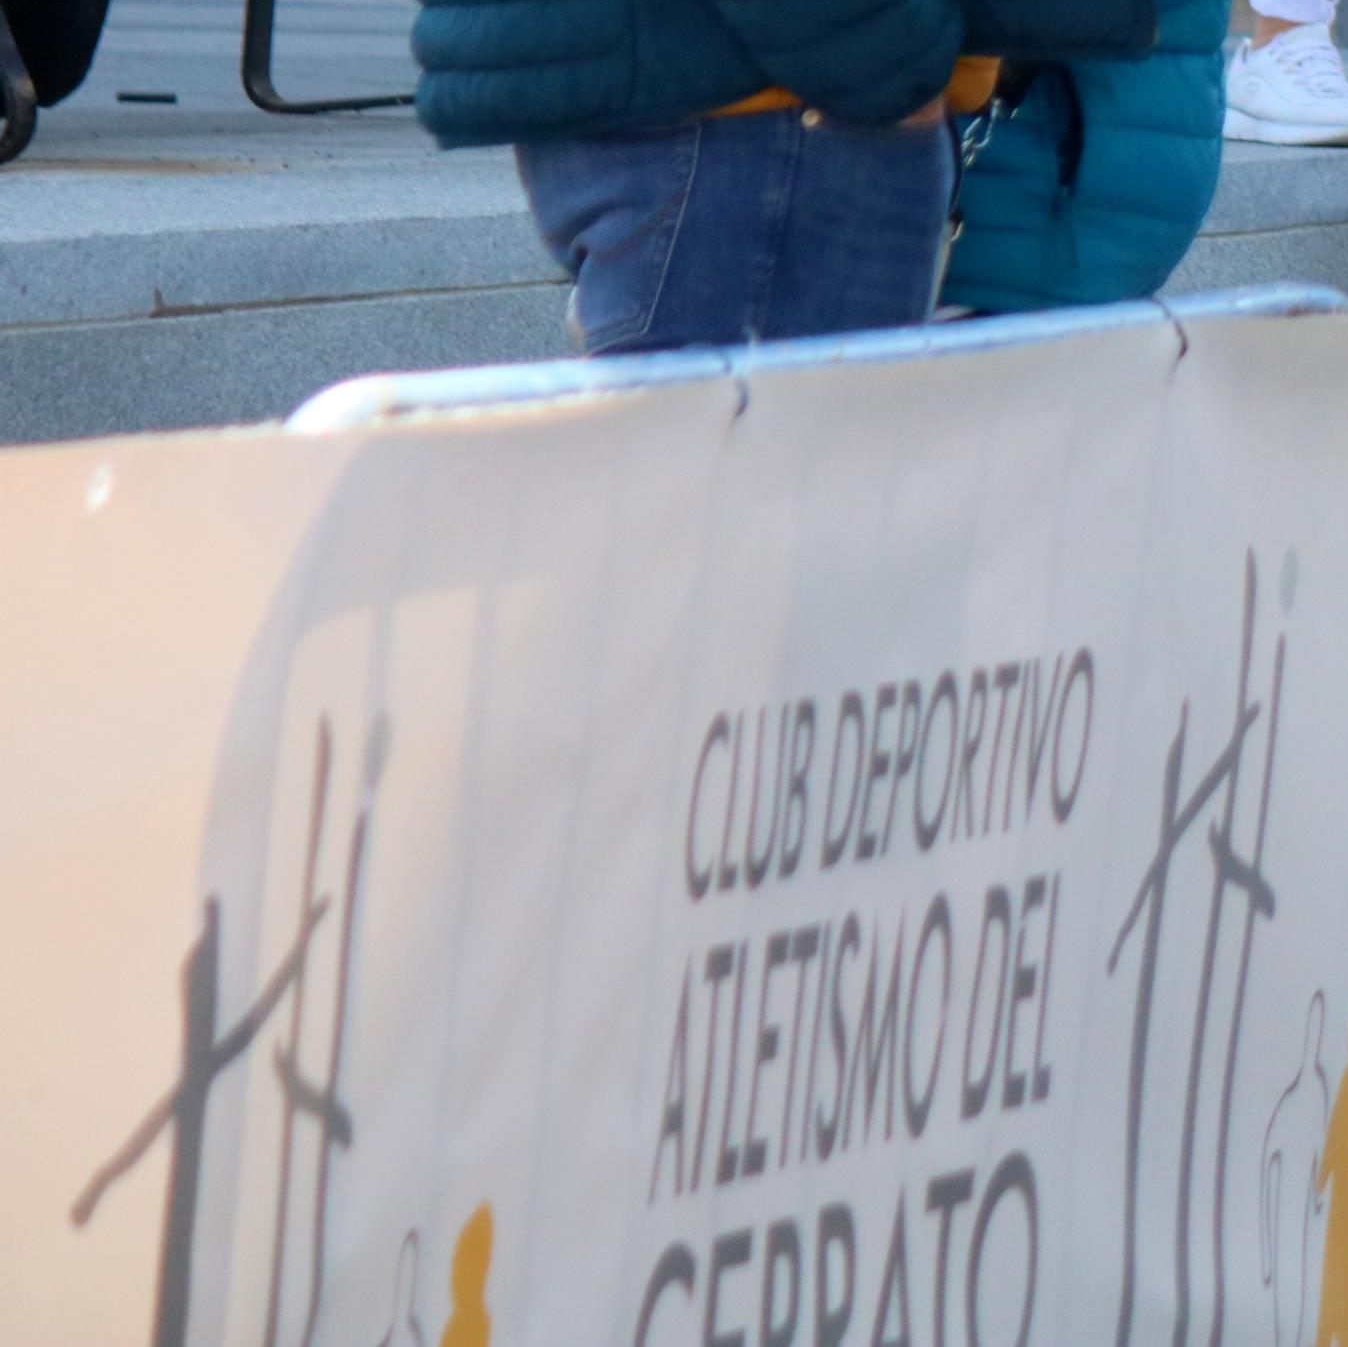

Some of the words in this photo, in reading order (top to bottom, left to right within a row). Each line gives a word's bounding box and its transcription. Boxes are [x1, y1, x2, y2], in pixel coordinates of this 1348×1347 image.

[685, 697, 817, 904] CLUB
[819, 645, 1095, 871] DEPORTIVO
[647, 889, 953, 1208] ATLETISMO
[960, 871, 1062, 1121] DEL
